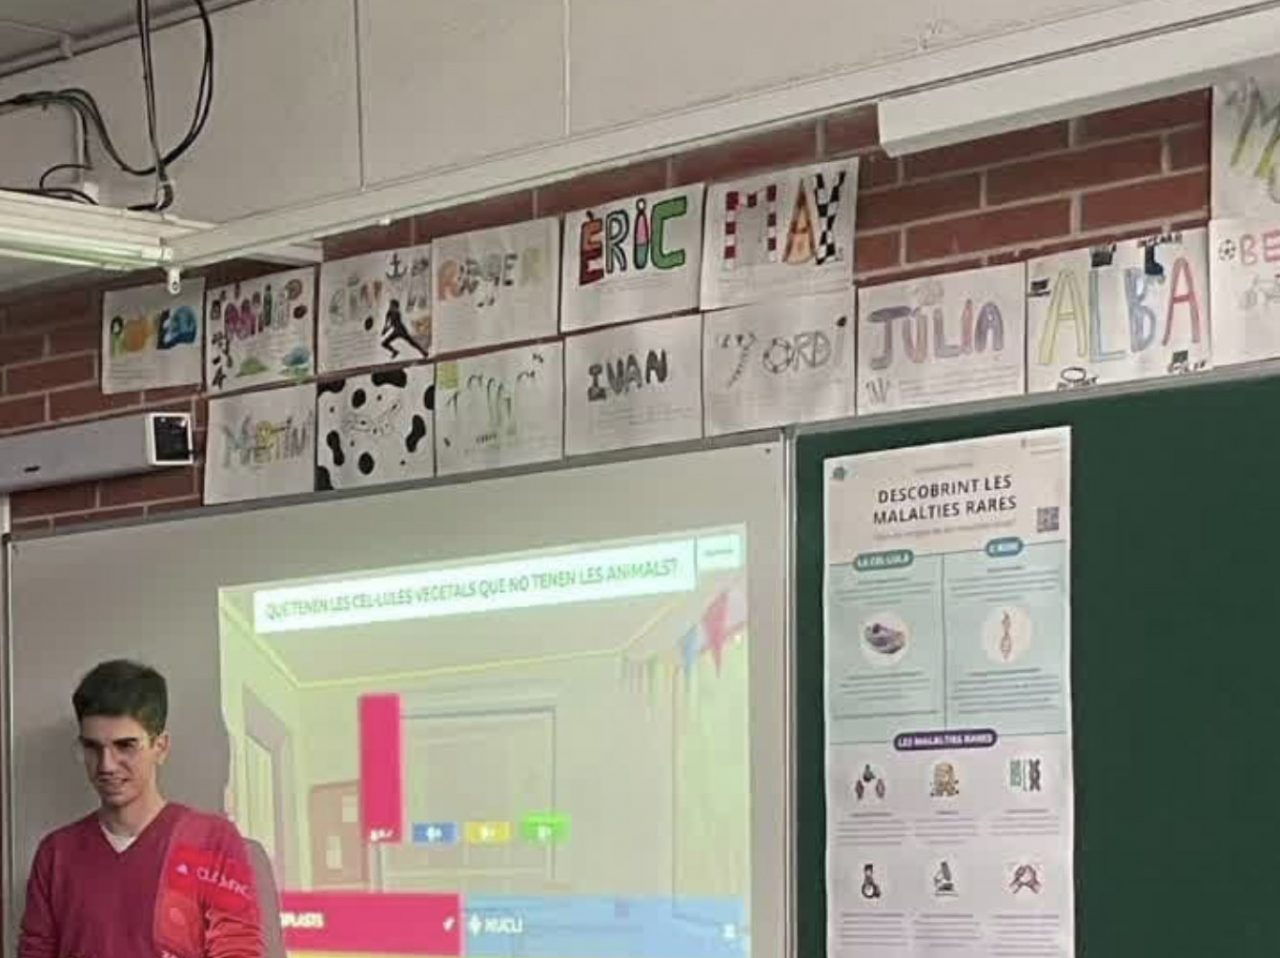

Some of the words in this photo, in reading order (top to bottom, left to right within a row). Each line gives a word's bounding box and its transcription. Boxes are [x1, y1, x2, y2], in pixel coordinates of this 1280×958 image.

[1039, 255, 1201, 365] ALBA
[587, 347, 668, 402] IVAN
[877, 478, 979, 504] DESCOBRINT
[984, 474, 1013, 491] LES
[873, 502, 961, 526] MALALTIES
[966, 496, 1018, 516] RARES
[509, 575, 529, 593] NO
[532, 570, 576, 588] TENEN
[579, 566, 603, 585] LES
